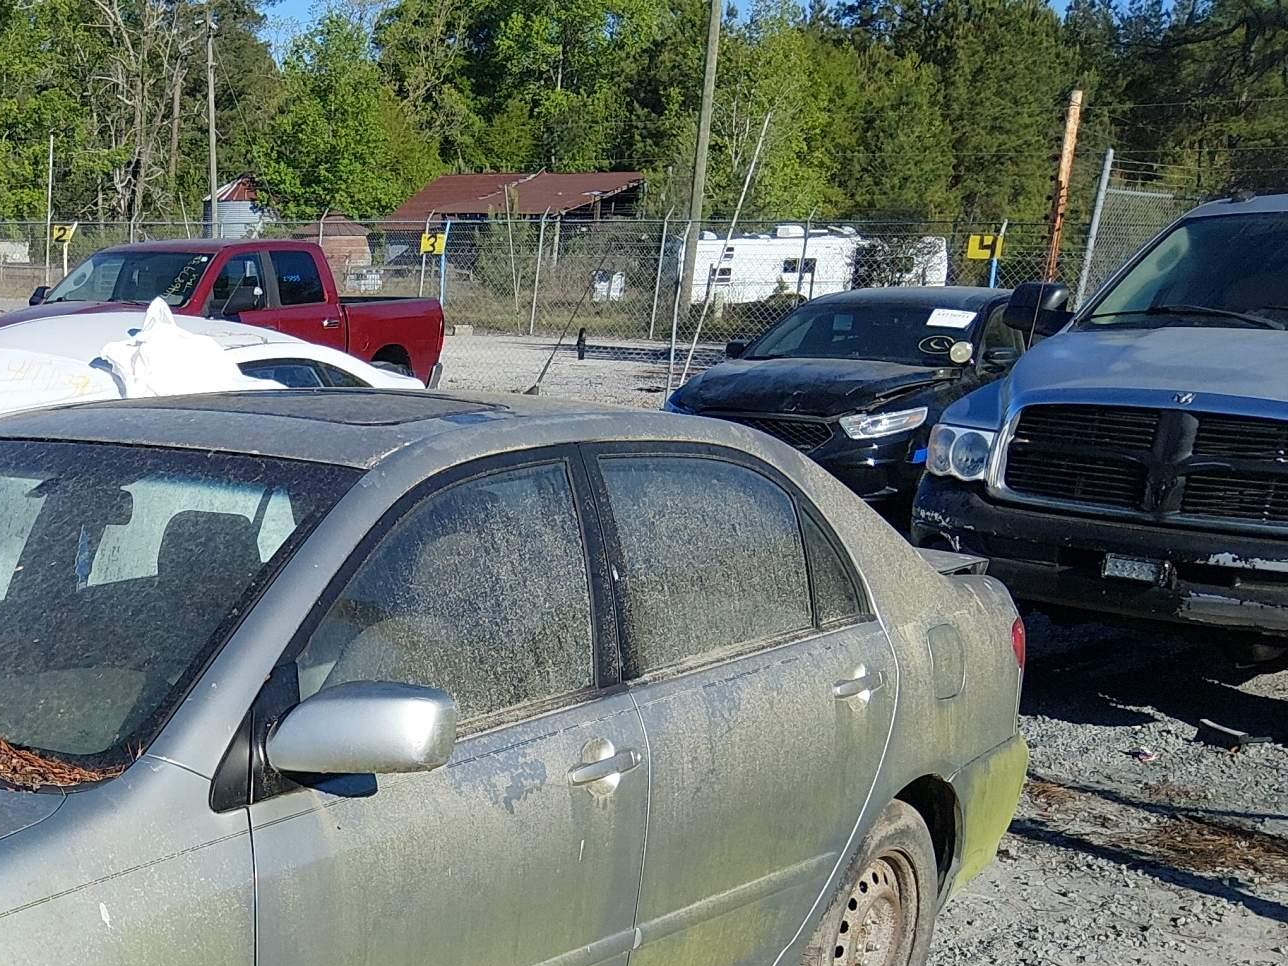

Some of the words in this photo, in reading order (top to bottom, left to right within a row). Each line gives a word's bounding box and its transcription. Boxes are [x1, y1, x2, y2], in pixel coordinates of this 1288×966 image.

[55, 226, 67, 242] 2
[423, 234, 438, 253] 3
[978, 234, 999, 257] 4
